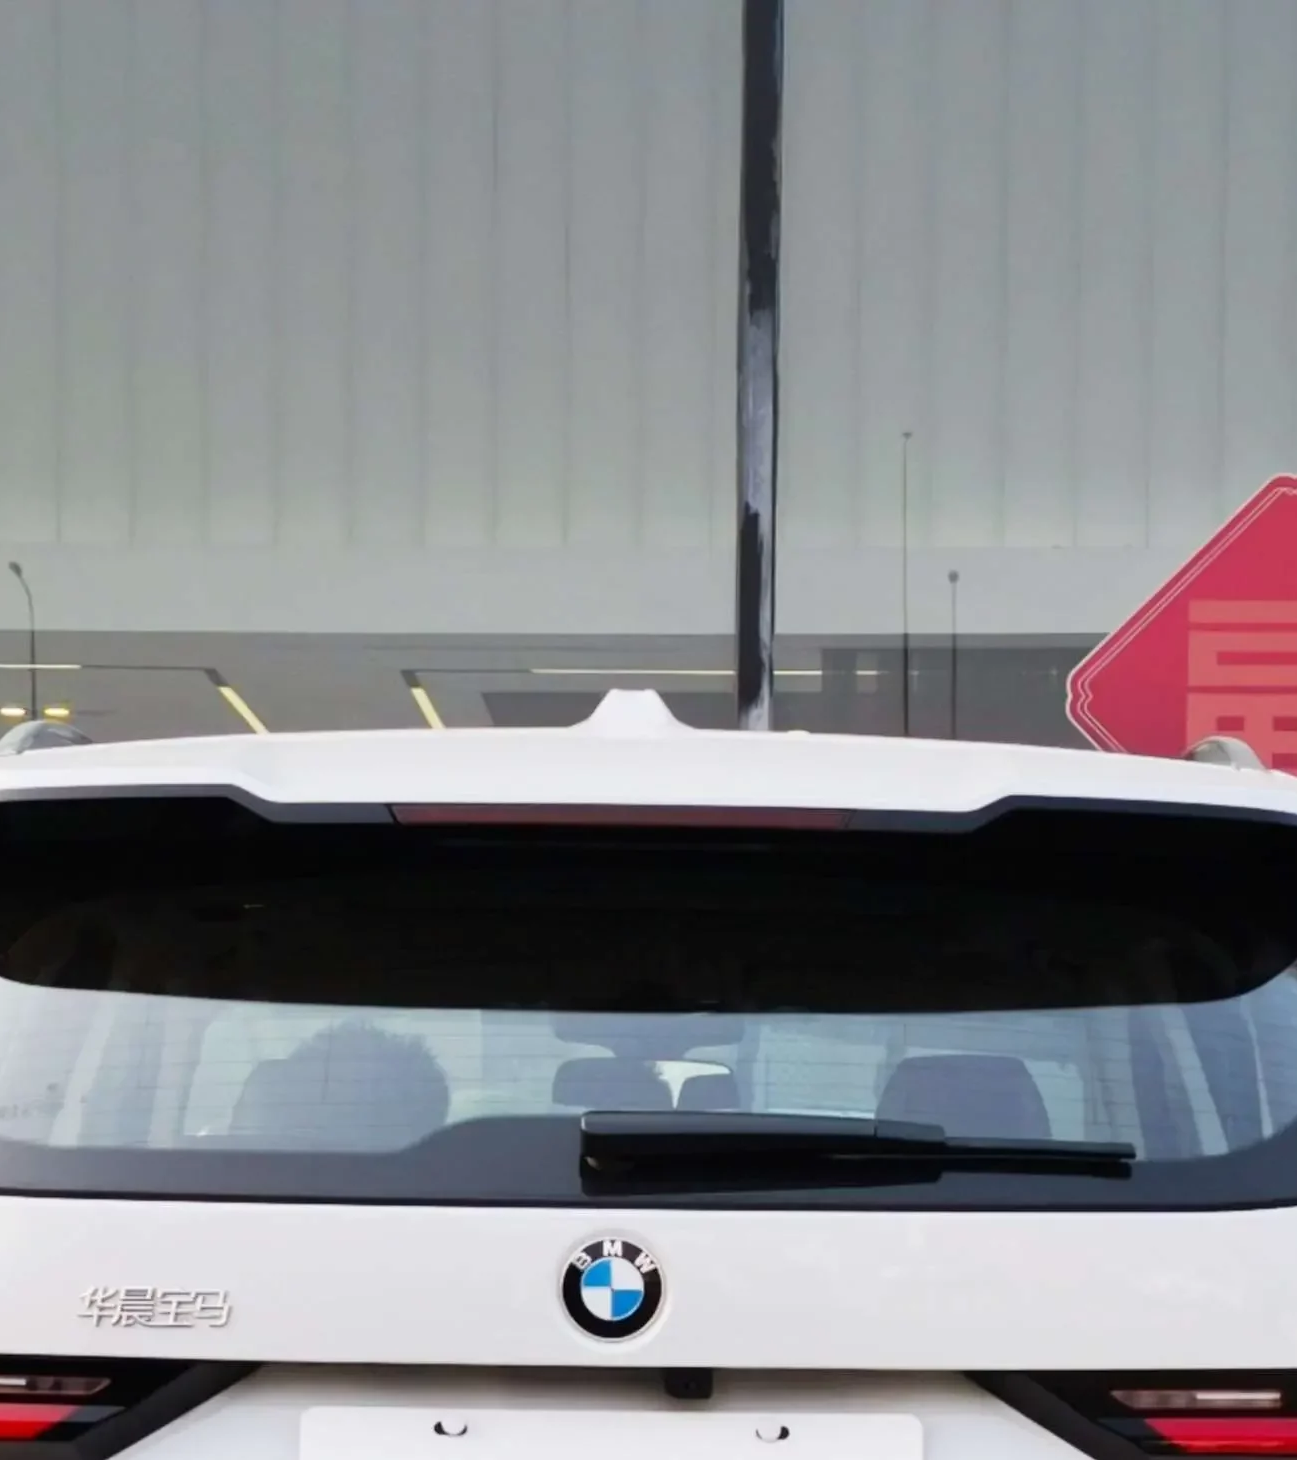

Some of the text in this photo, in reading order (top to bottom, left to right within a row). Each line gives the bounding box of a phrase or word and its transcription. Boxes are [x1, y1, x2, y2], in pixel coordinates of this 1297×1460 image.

[570, 1237, 658, 1275] BMW
[77, 1285, 233, 1328] 华晨宝马
